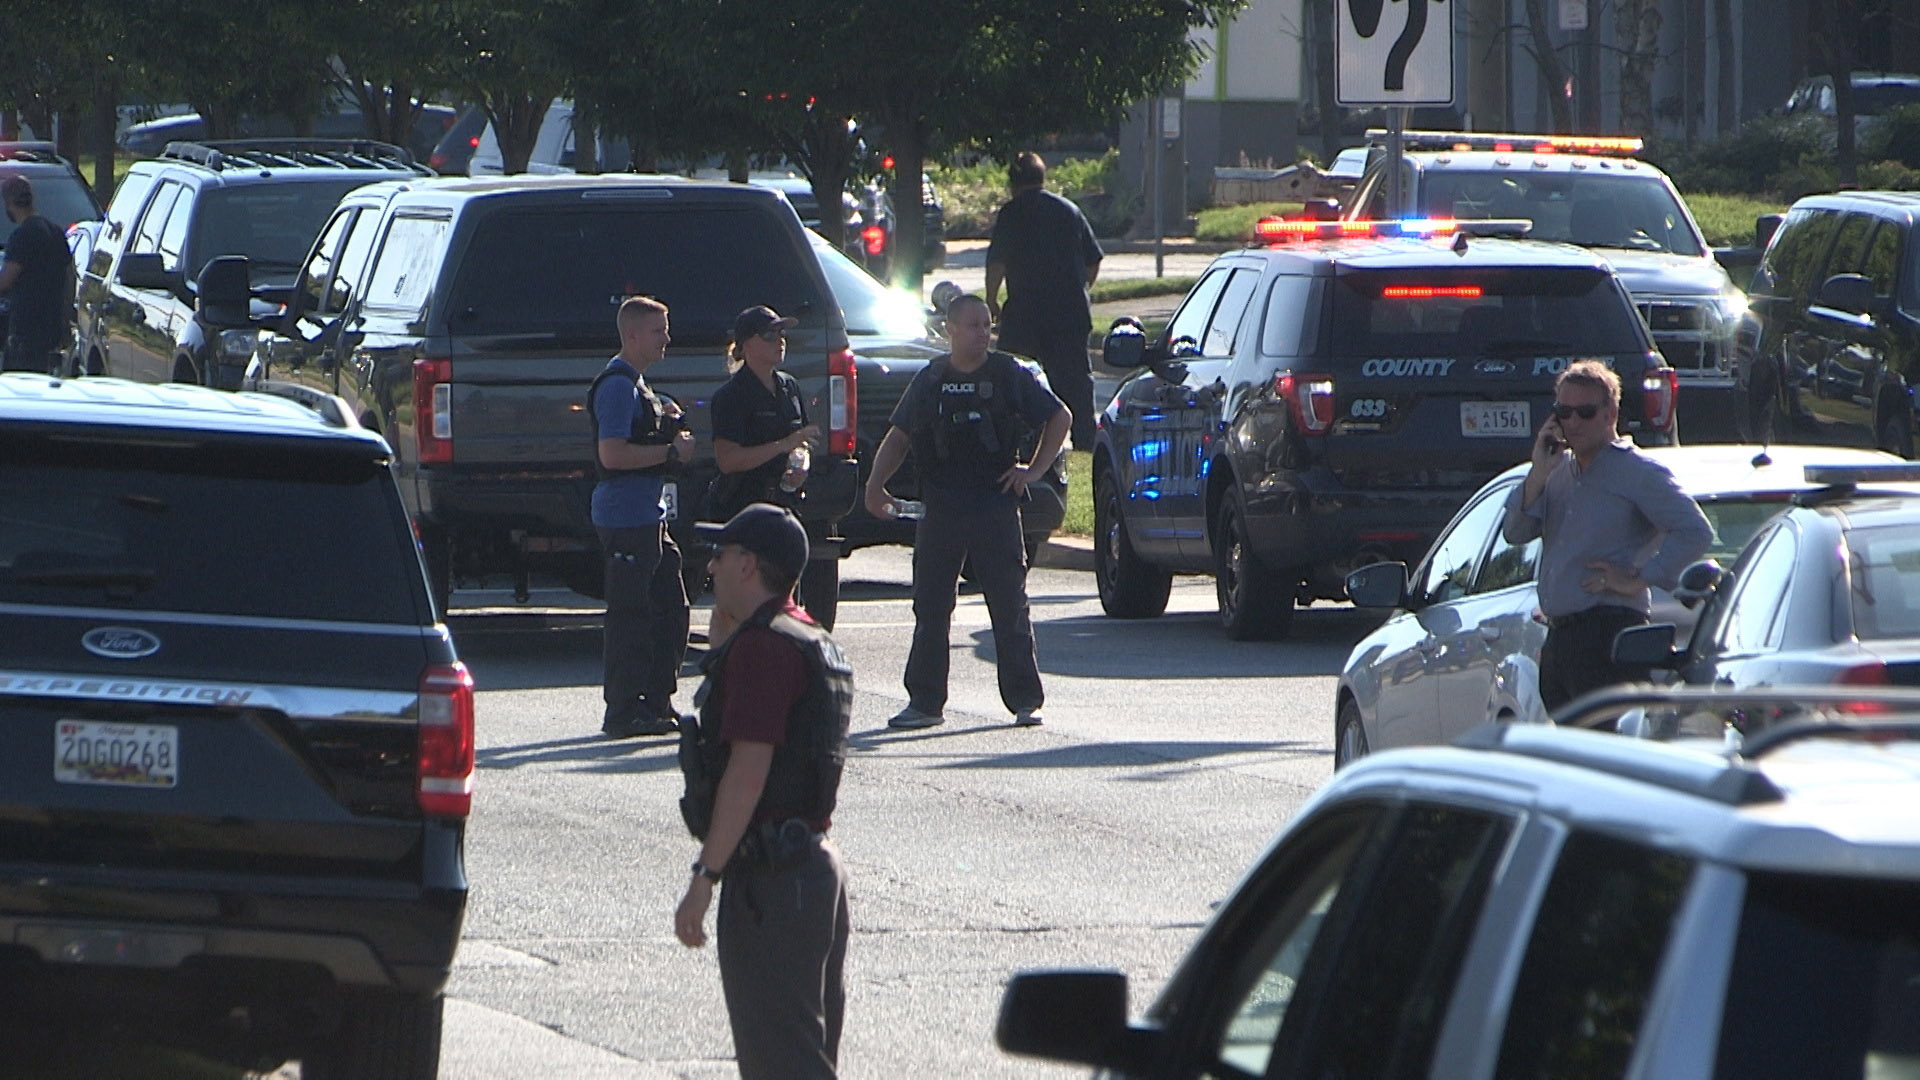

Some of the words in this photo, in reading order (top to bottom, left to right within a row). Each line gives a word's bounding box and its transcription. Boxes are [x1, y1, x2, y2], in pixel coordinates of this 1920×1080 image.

[1362, 358, 1456, 377] COUNTY
[942, 383, 975, 393] POLICE
[1351, 399, 1386, 416] 633
[1493, 411, 1526, 428] 1561
[101, 632, 141, 650] Ford
